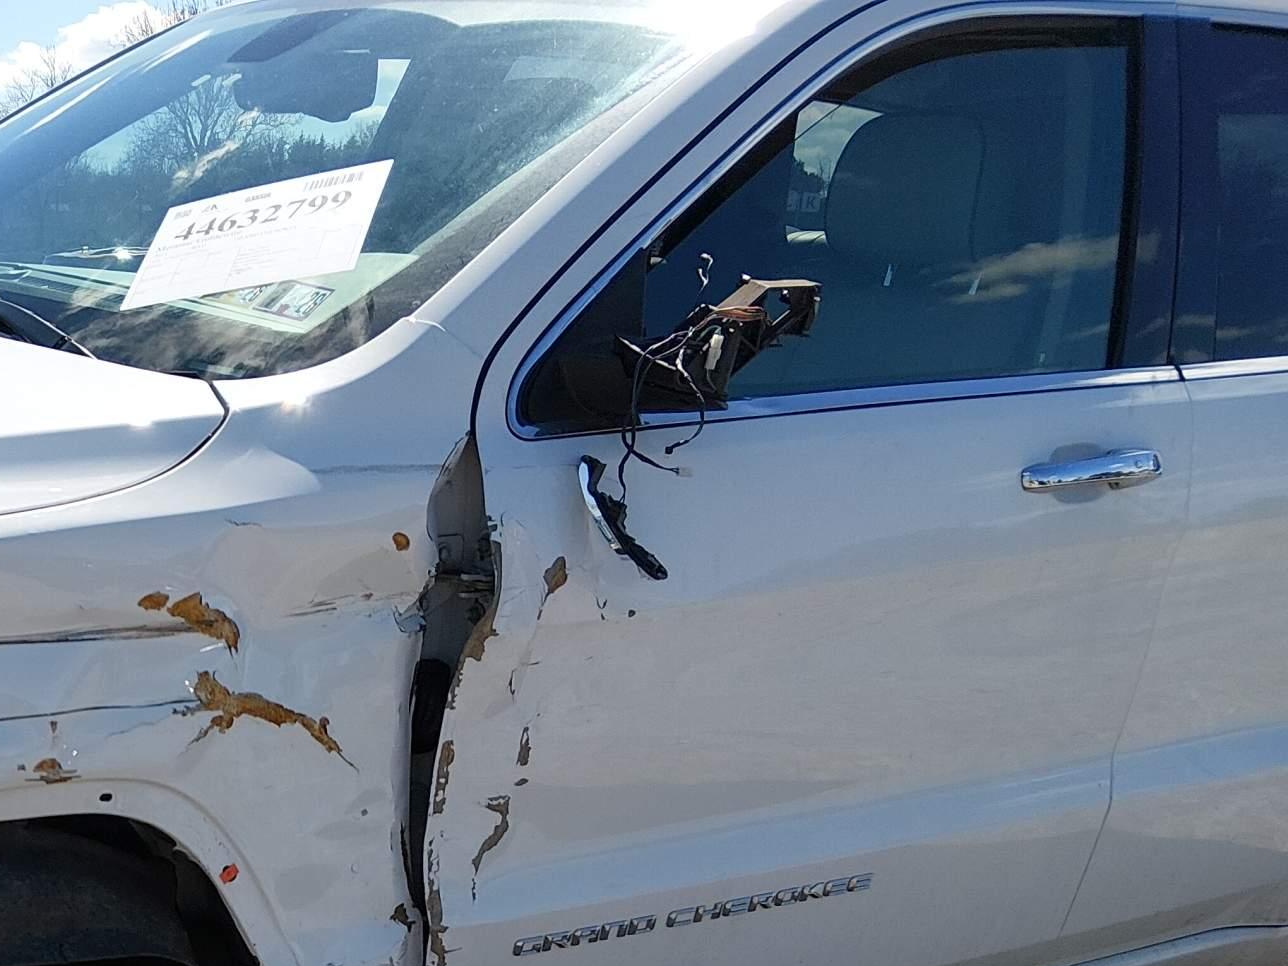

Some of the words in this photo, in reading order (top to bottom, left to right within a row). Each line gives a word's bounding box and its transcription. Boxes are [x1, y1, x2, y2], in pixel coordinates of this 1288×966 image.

[174, 189, 352, 241] 44632799
[512, 914, 657, 957] GRAND
[665, 872, 875, 928] CHEROKEE
